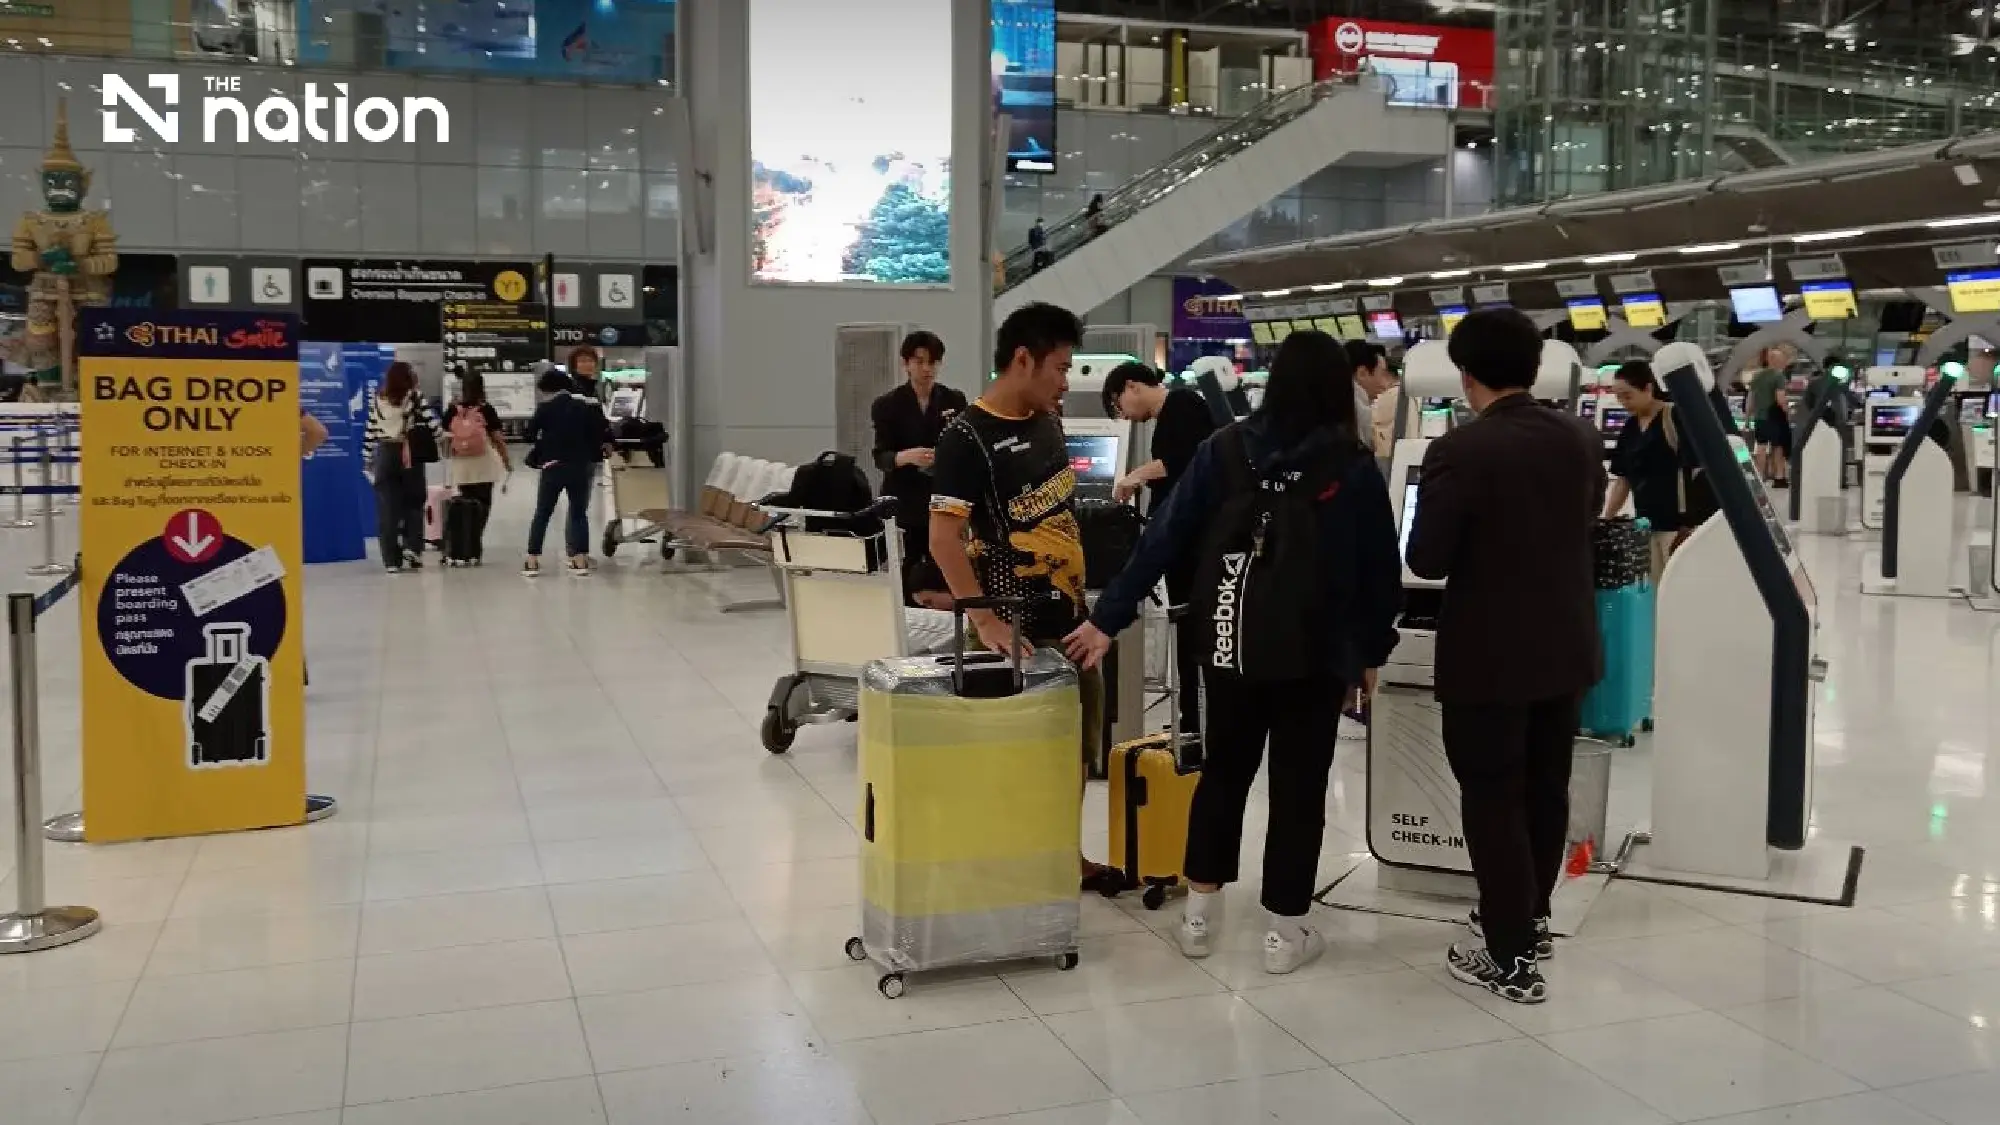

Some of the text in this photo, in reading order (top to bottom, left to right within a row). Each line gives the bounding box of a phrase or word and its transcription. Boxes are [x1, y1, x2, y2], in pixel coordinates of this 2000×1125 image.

[94, 375, 172, 401] BAG
[185, 377, 287, 403] DROP
[143, 405, 242, 431] ONLY
[110, 446, 273, 457] FOR INTERNET & KIOSK
[159, 459, 227, 469] CHECK-IN
[112, 496, 135, 508] Bag
[115, 573, 159, 584] Please
[115, 586, 167, 601] present
[115, 598, 178, 610] boarding
[115, 613, 147, 626] pass
[1212, 577, 1238, 669] Reebok
[1392, 814, 1429, 827] SELF
[1392, 830, 1464, 848] CHECK-IN
